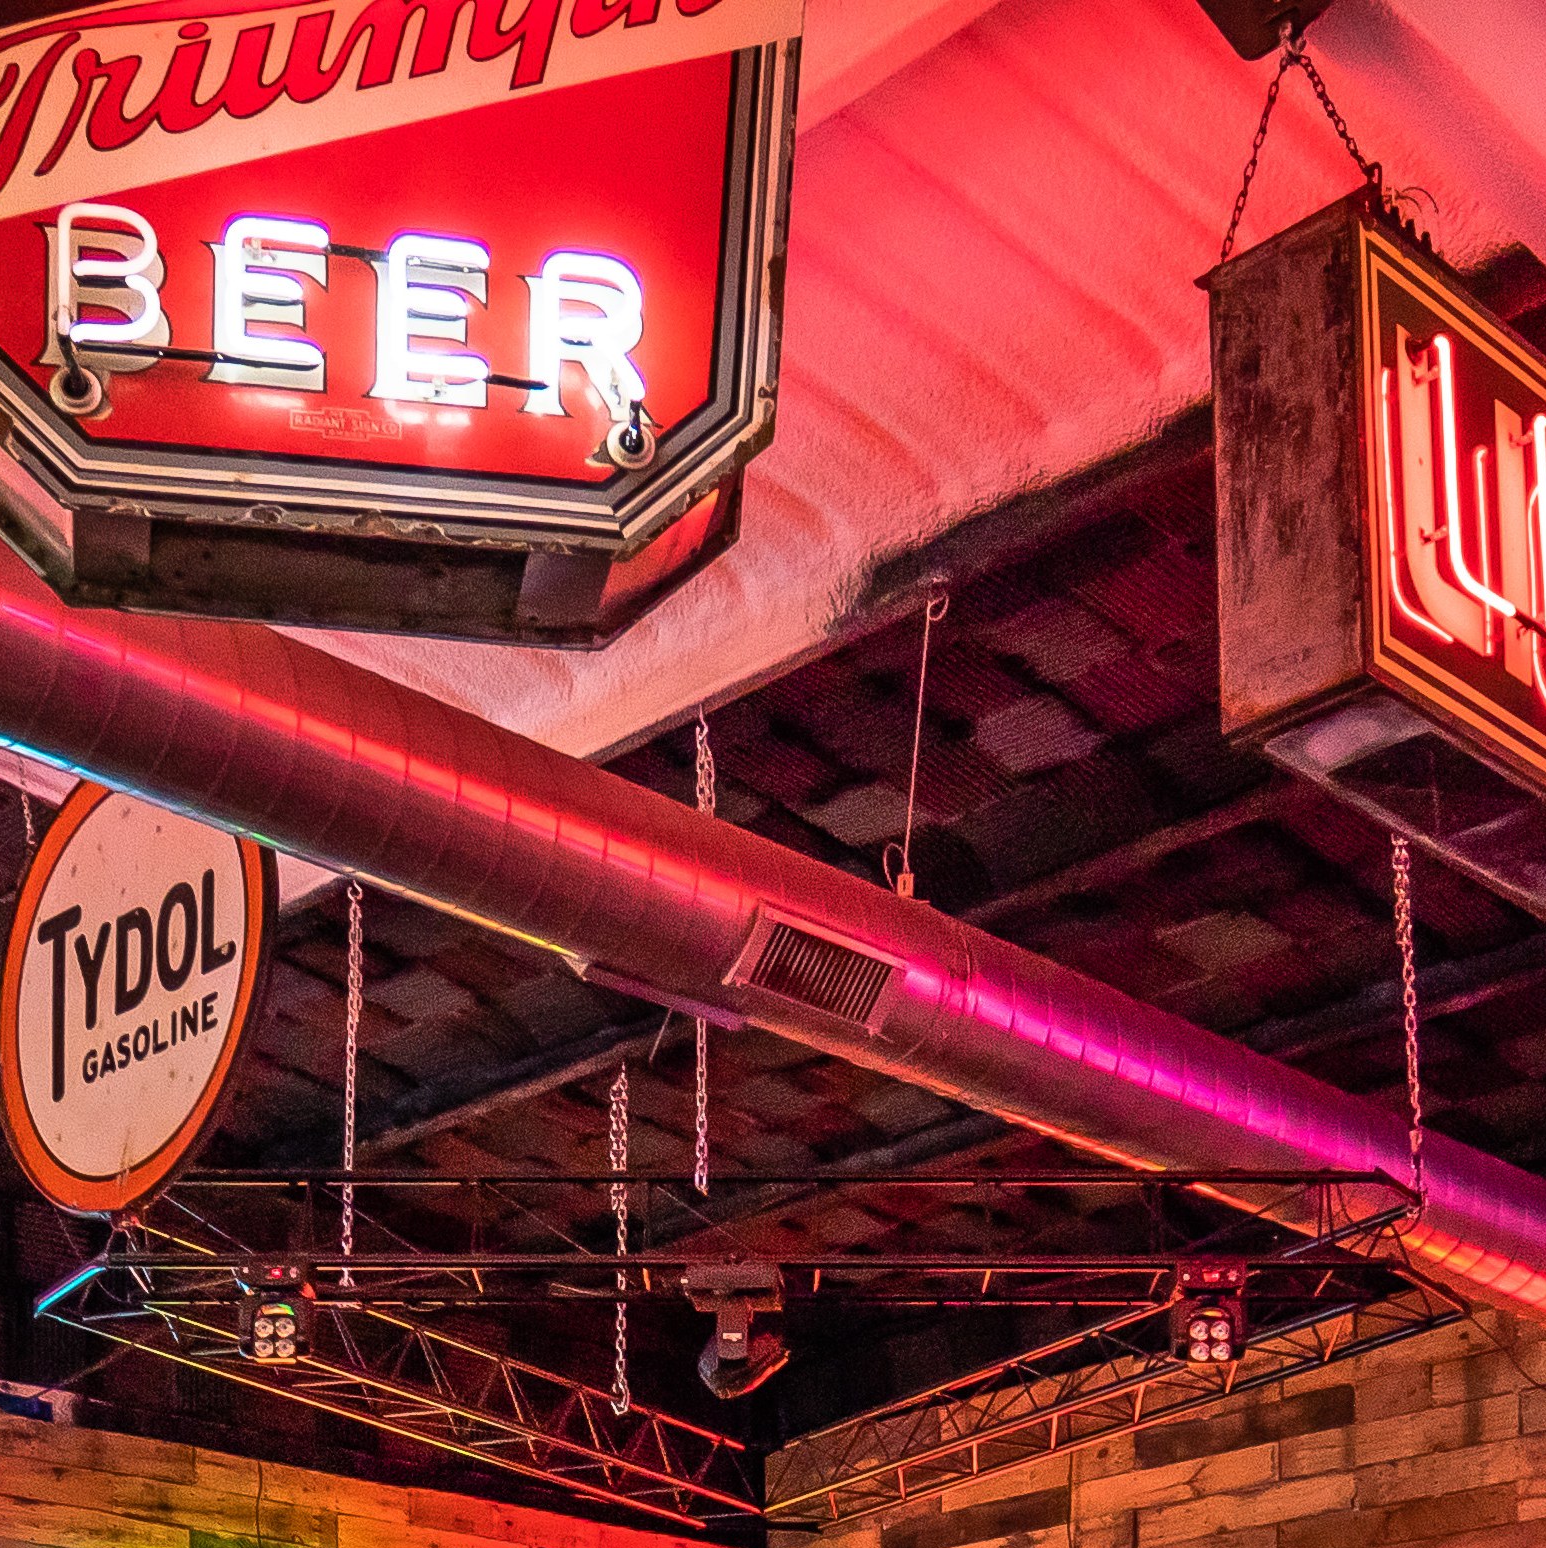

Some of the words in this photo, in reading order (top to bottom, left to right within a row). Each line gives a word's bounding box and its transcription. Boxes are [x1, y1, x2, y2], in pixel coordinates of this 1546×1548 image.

[41, 203, 660, 427] BEER
[37, 868, 237, 1102] TYDOL
[82, 991, 219, 1084] GASOLINE
